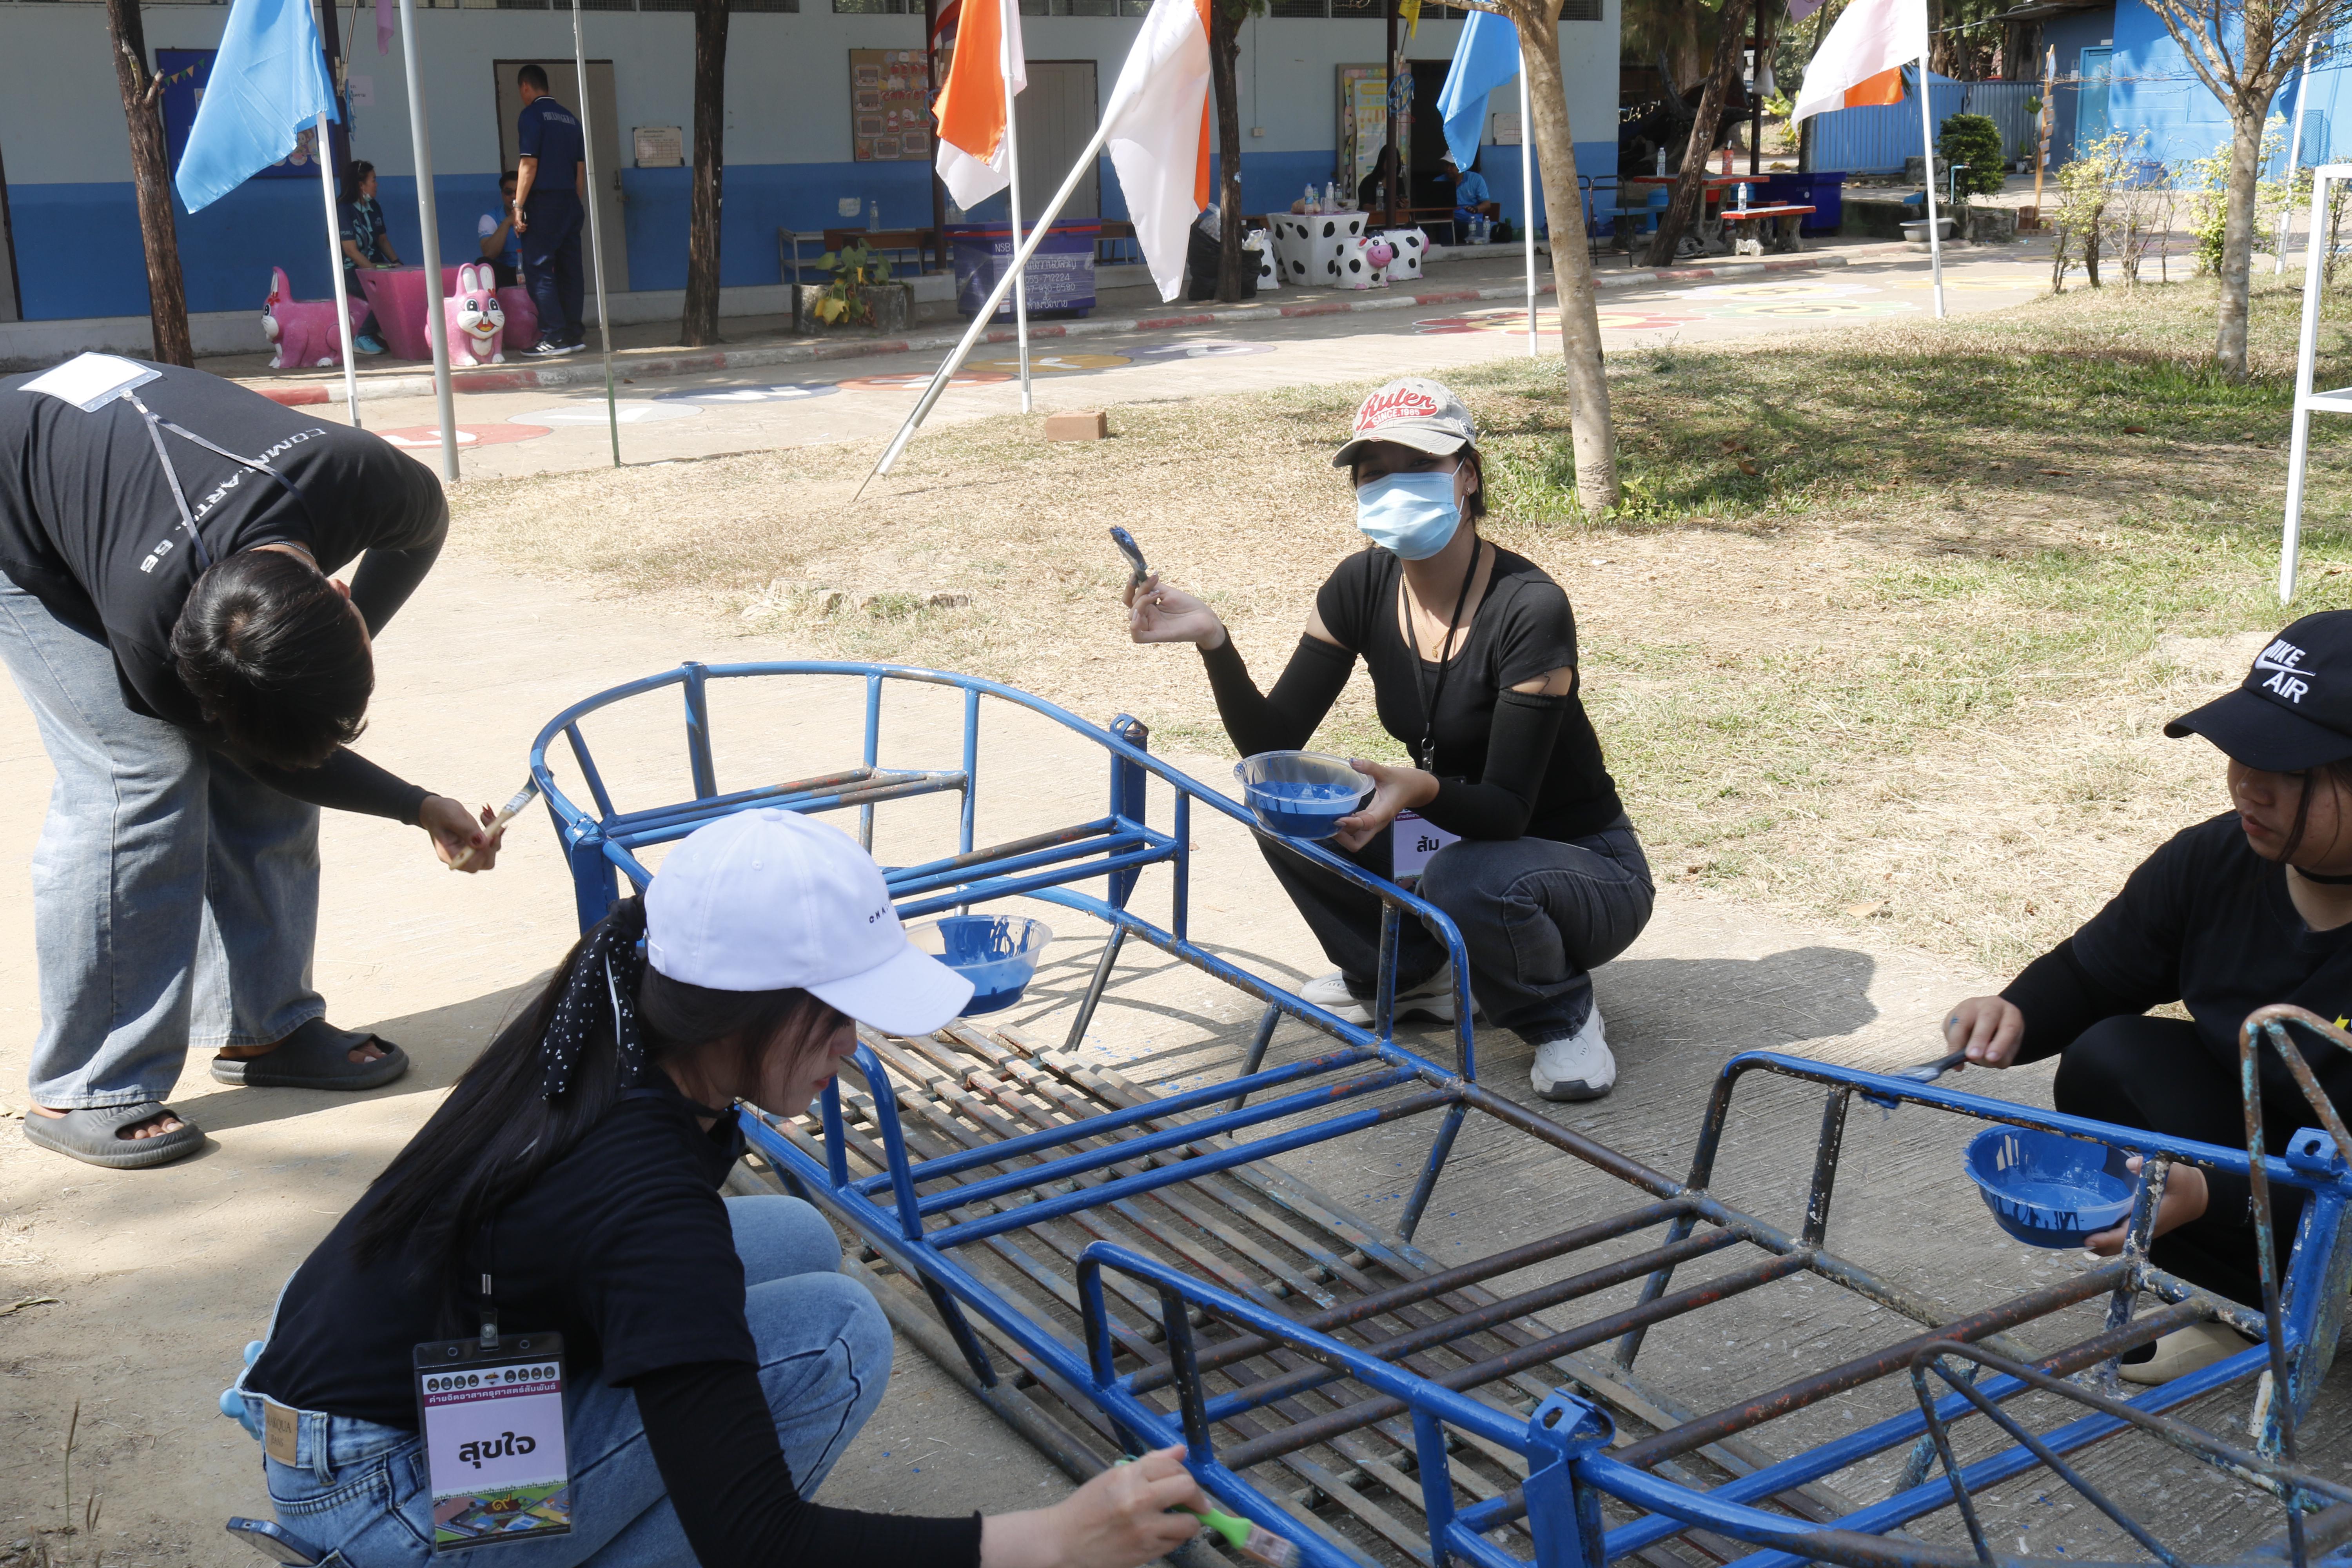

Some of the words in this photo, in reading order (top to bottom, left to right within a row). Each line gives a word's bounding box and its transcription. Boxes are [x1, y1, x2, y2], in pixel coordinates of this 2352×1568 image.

[995, 243, 1011, 252] NSB
[1025, 273, 1070, 284] 055-712224
[1025, 283, 1075, 293] 97-930-6580
[1356, 388, 1438, 431] Ruler
[2265, 639, 2306, 668] NIKE
[2262, 671, 2309, 704] AIR
[1417, 835, 1439, 852] ส้ม
[459, 1432, 536, 1469] สุขใจ
